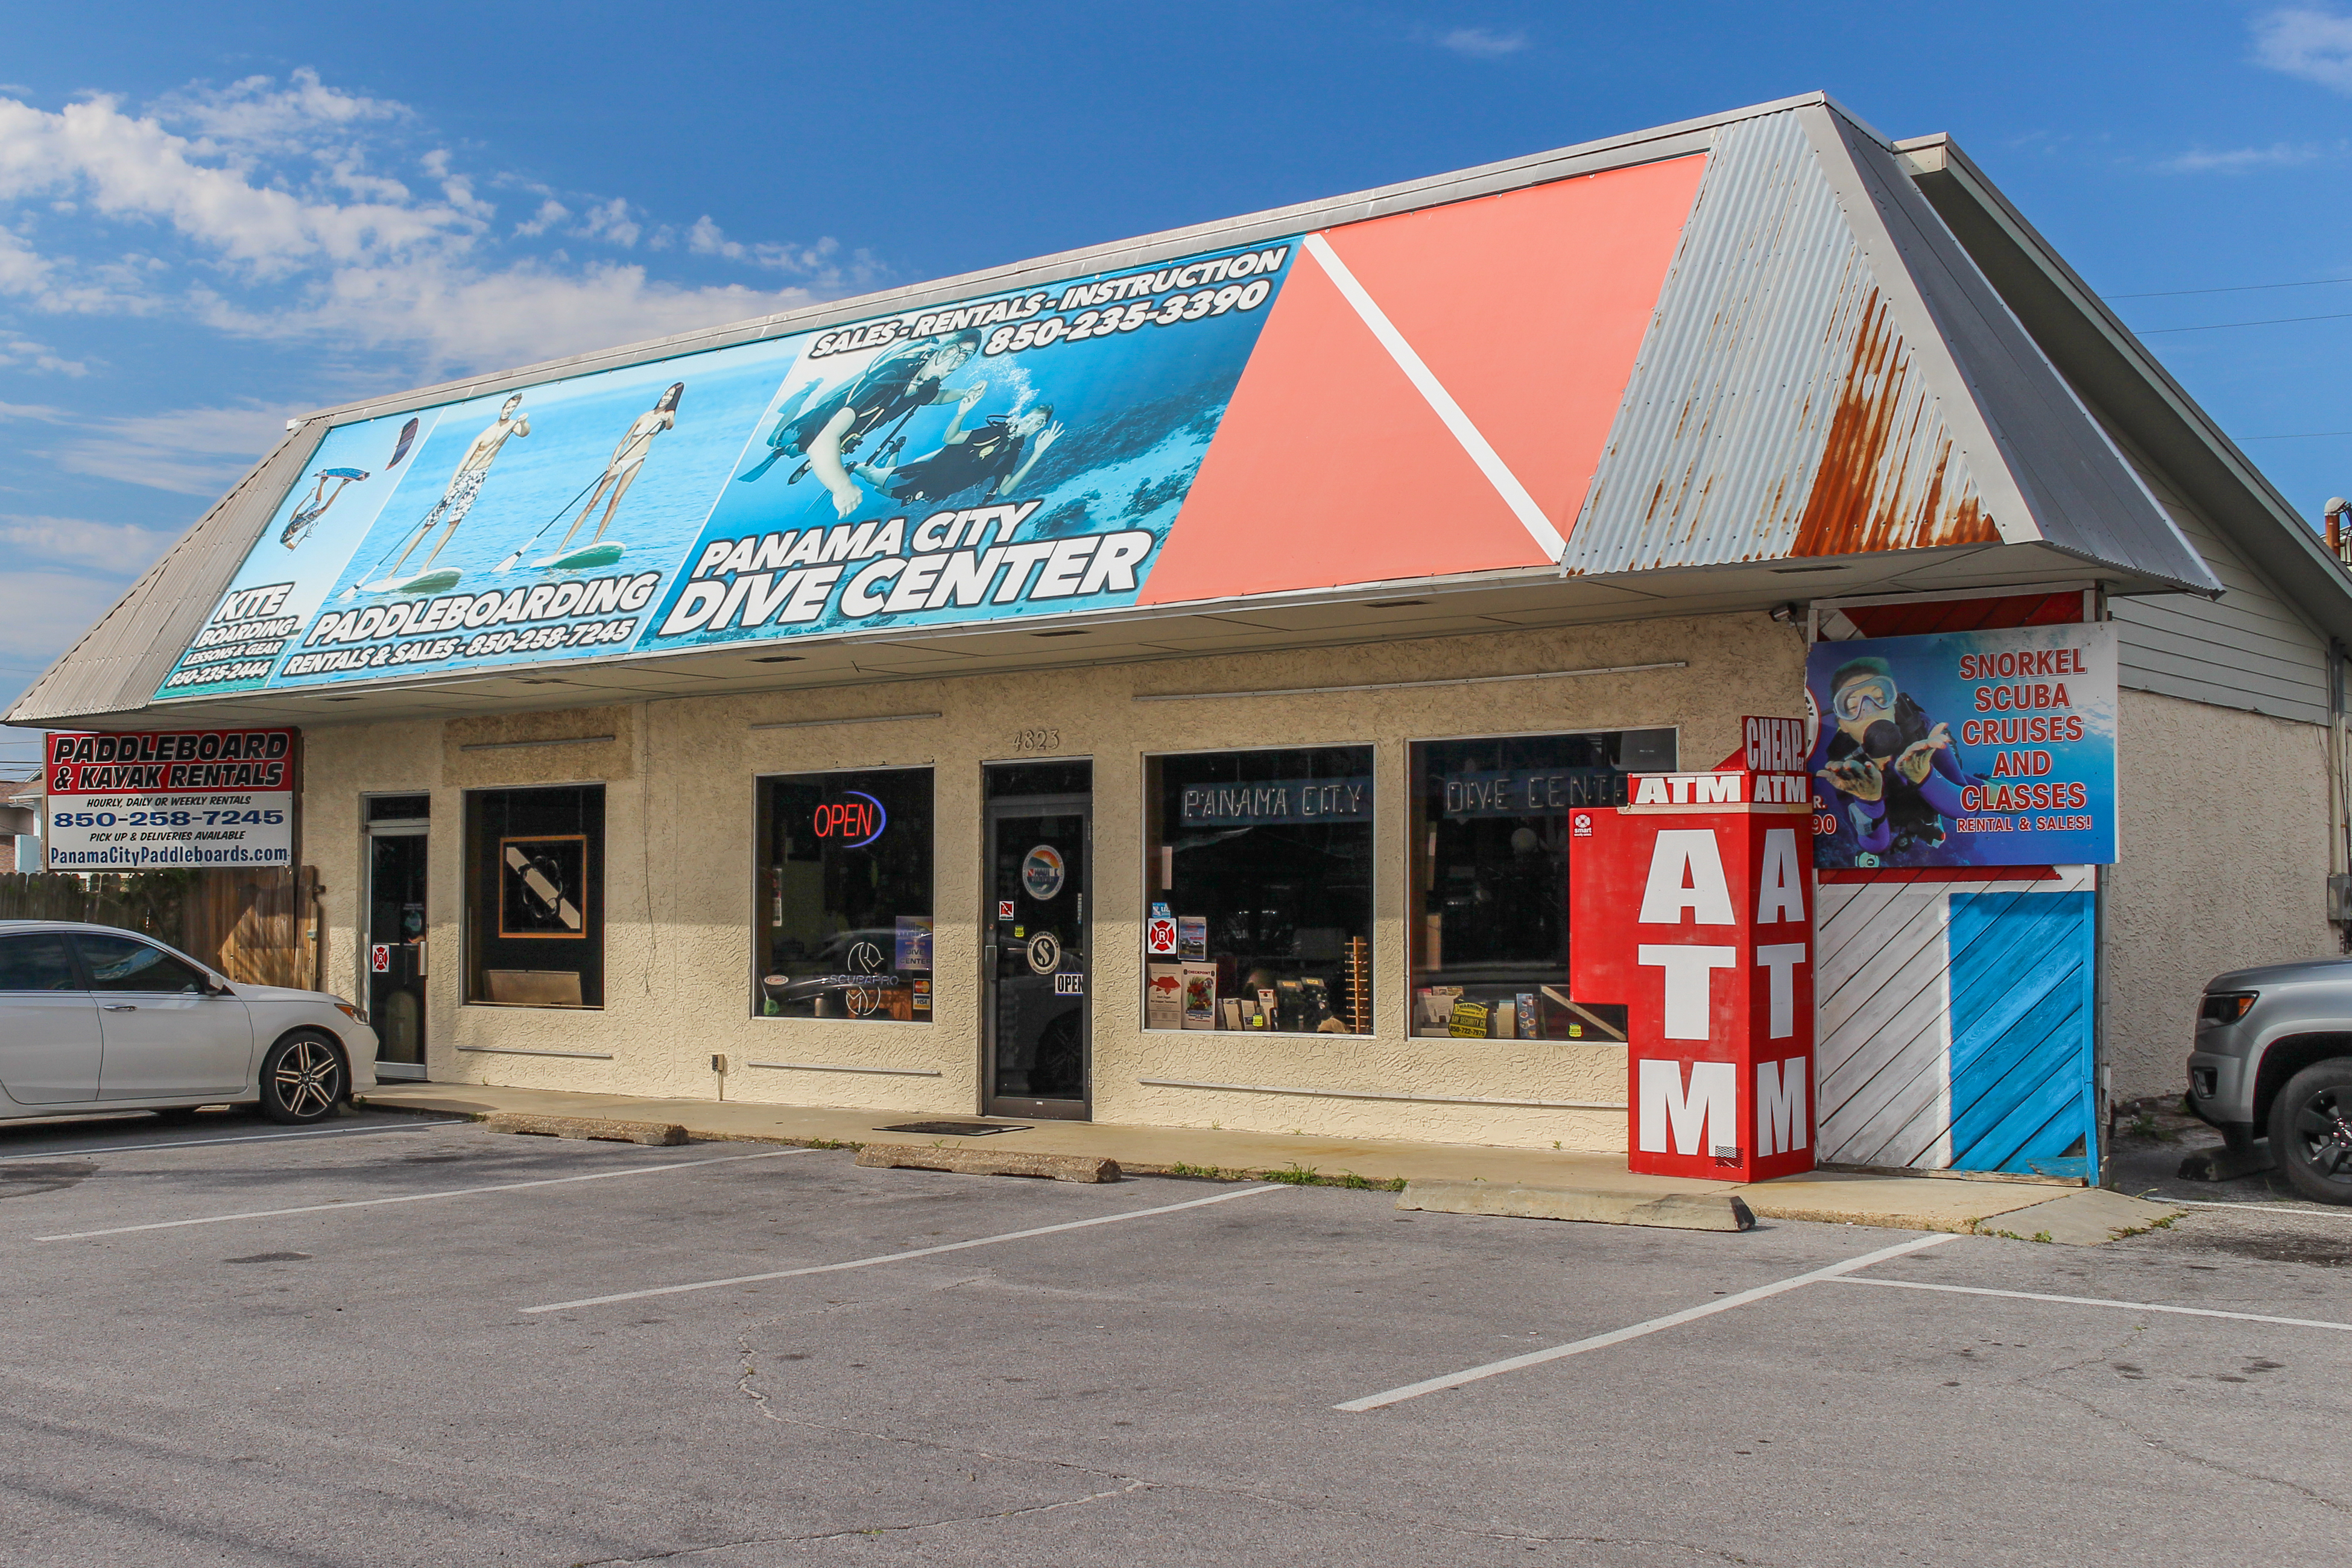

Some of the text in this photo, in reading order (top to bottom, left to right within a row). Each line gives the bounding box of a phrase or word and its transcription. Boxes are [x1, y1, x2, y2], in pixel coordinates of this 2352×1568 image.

[811, 321, 901, 359] SALES
[909, 297, 1042, 339] RENTALS
[1056, 247, 1288, 311] INSTRUCTION
[983, 279, 1271, 357] 850-235-3390
[691, 500, 1042, 580] PANAMA CITY
[657, 530, 1154, 637] DIVE CENTER
[211, 582, 295, 624] KITE
[303, 571, 661, 646] PADDLEBOARDING
[194, 616, 299, 649] BOARDING
[281, 645, 370, 677] RENTALS
[369, 643, 393, 666] &
[389, 637, 462, 665] SALES
[465, 616, 639, 656] 850-258-7245
[181, 640, 286, 667] LESSONS & GEAR
[1959, 648, 2087, 680] SNORKEL
[165, 659, 274, 688] 850-235-2444
[1974, 683, 2072, 712] SCUBA
[1012, 729, 1060, 751] 4823
[1962, 715, 2084, 746] CRUISES
[53, 733, 289, 764] PADDLEBOARD
[53, 762, 285, 791] & KAYAK RENTALS
[1992, 750, 2052, 778] AND
[87, 796, 251, 808] HOURLY, DAILY OR WEEKLY RENTALS
[1184, 785, 1362, 818] PANAMA CITY
[1448, 776, 1627, 812] DIVE CENTE
[1635, 776, 1740, 804] ATM
[1754, 776, 1806, 803] ATM
[1961, 782, 2087, 811] CLASSES
[54, 810, 283, 827] 850-258-7245
[814, 804, 873, 837] OPEN
[1957, 815, 2092, 832] RENTAL & SALES!
[89, 831, 246, 841] PICK UP & DELIVERIES AVAILABLE
[51, 846, 287, 866] PanamaCityPaddleboards.com
[1028, 932, 1059, 949] SCUBAPRO
[1159, 931, 1165, 941] R
[830, 974, 899, 985] SCUBAPRO
[1057, 975, 1083, 993] OPEN
[1638, 829, 1736, 1157] ATM
[1757, 829, 1806, 1157] ATM
[1458, 1003, 1482, 1011] WARNING
[1460, 1017, 1478, 1025] SECURITY
[1450, 1025, 1485, 1036] 850-722-7979
